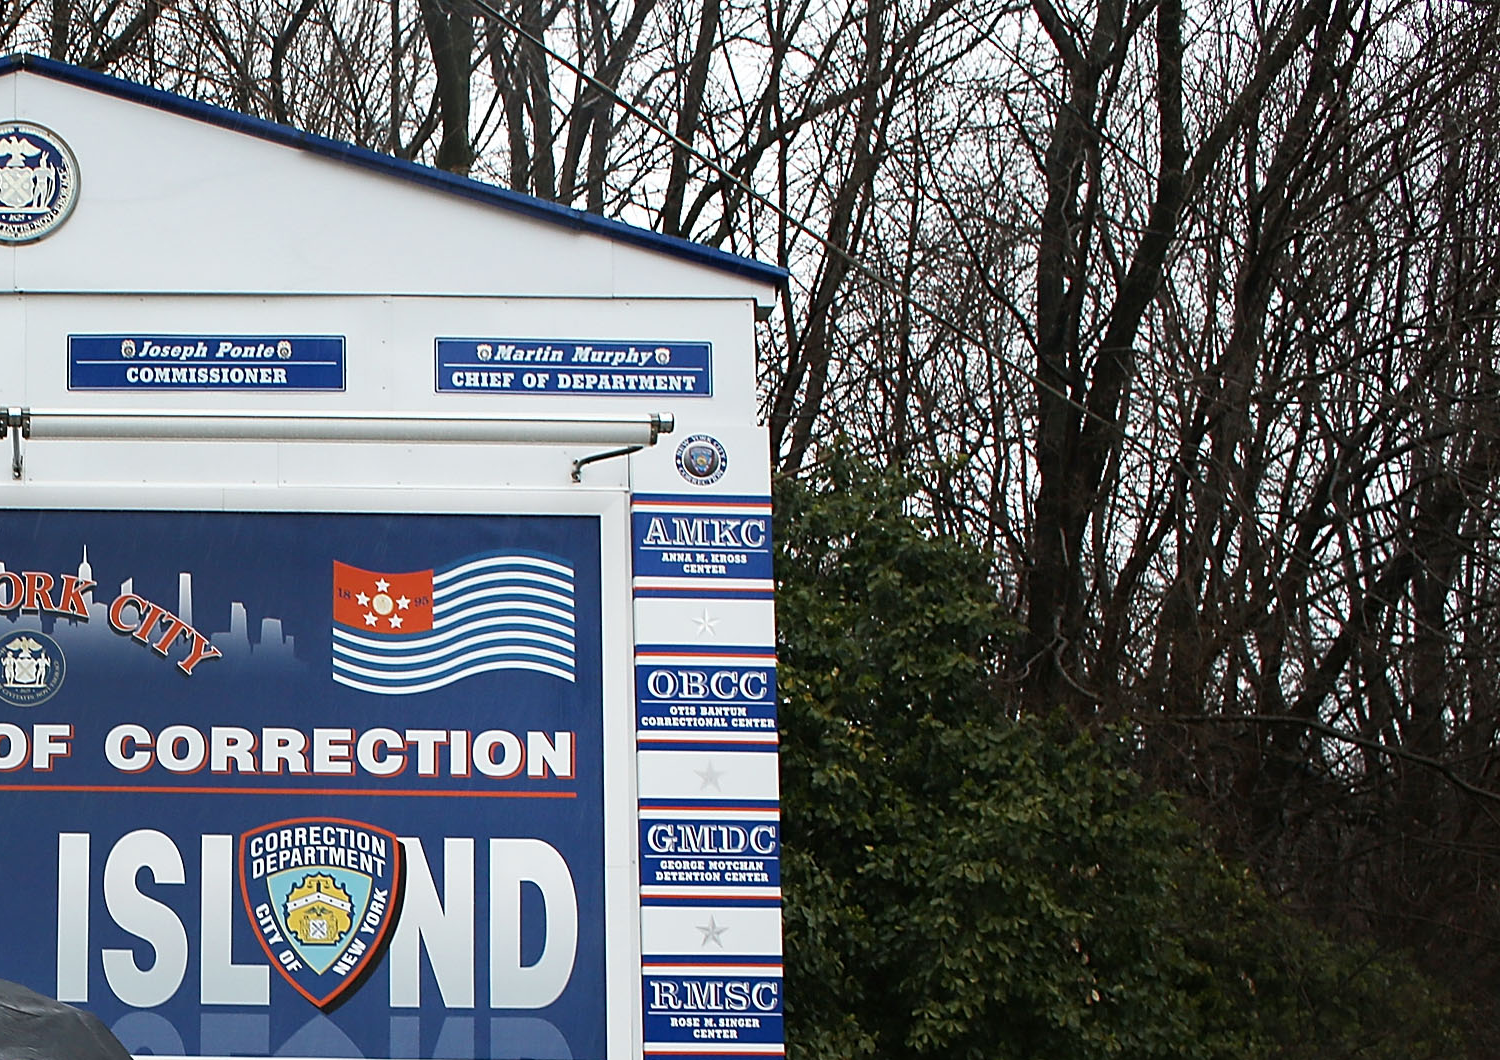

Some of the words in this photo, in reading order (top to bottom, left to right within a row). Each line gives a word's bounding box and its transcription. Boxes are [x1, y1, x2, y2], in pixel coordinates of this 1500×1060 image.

[138, 341, 208, 360] Joseph
[215, 341, 274, 358] Ponte
[494, 345, 564, 361] Martin
[571, 346, 653, 367] Murphy
[126, 367, 288, 384] COMMISSIONER
[451, 371, 515, 388] CHIEF
[522, 373, 550, 388] OF
[557, 373, 696, 391] DEPARTMENT
[643, 517, 766, 547] AMKC
[662, 552, 694, 563] ANNA
[712, 554, 748, 564] KROSS
[683, 564, 727, 574] CENTER
[109, 593, 223, 676] CITY
[646, 670, 768, 701] OBCC
[669, 705, 697, 716] OTIS
[699, 705, 747, 716] BANTUM
[641, 716, 729, 727] CORRECTIONAL
[731, 717, 776, 728] CENTER
[104, 723, 576, 778] CORRECTION
[250, 826, 387, 858] CORRECTION
[647, 823, 777, 855] GMDC
[252, 846, 387, 879] DEPARTMENT
[660, 860, 706, 871] GEORGE
[708, 860, 764, 872] MOTCHAN
[655, 870, 723, 882] DETENTION
[724, 871, 769, 882] CENTER
[56, 828, 579, 1009] ISLND
[255, 902, 284, 945] CITY
[278, 949, 303, 972] OF
[332, 937, 367, 976] NEW
[360, 887, 388, 934] YORK
[648, 980, 778, 1011] RMSC
[670, 1017, 702, 1028] ROSE
[718, 1018, 760, 1028] SINGER
[693, 1028, 738, 1039] CENTER
